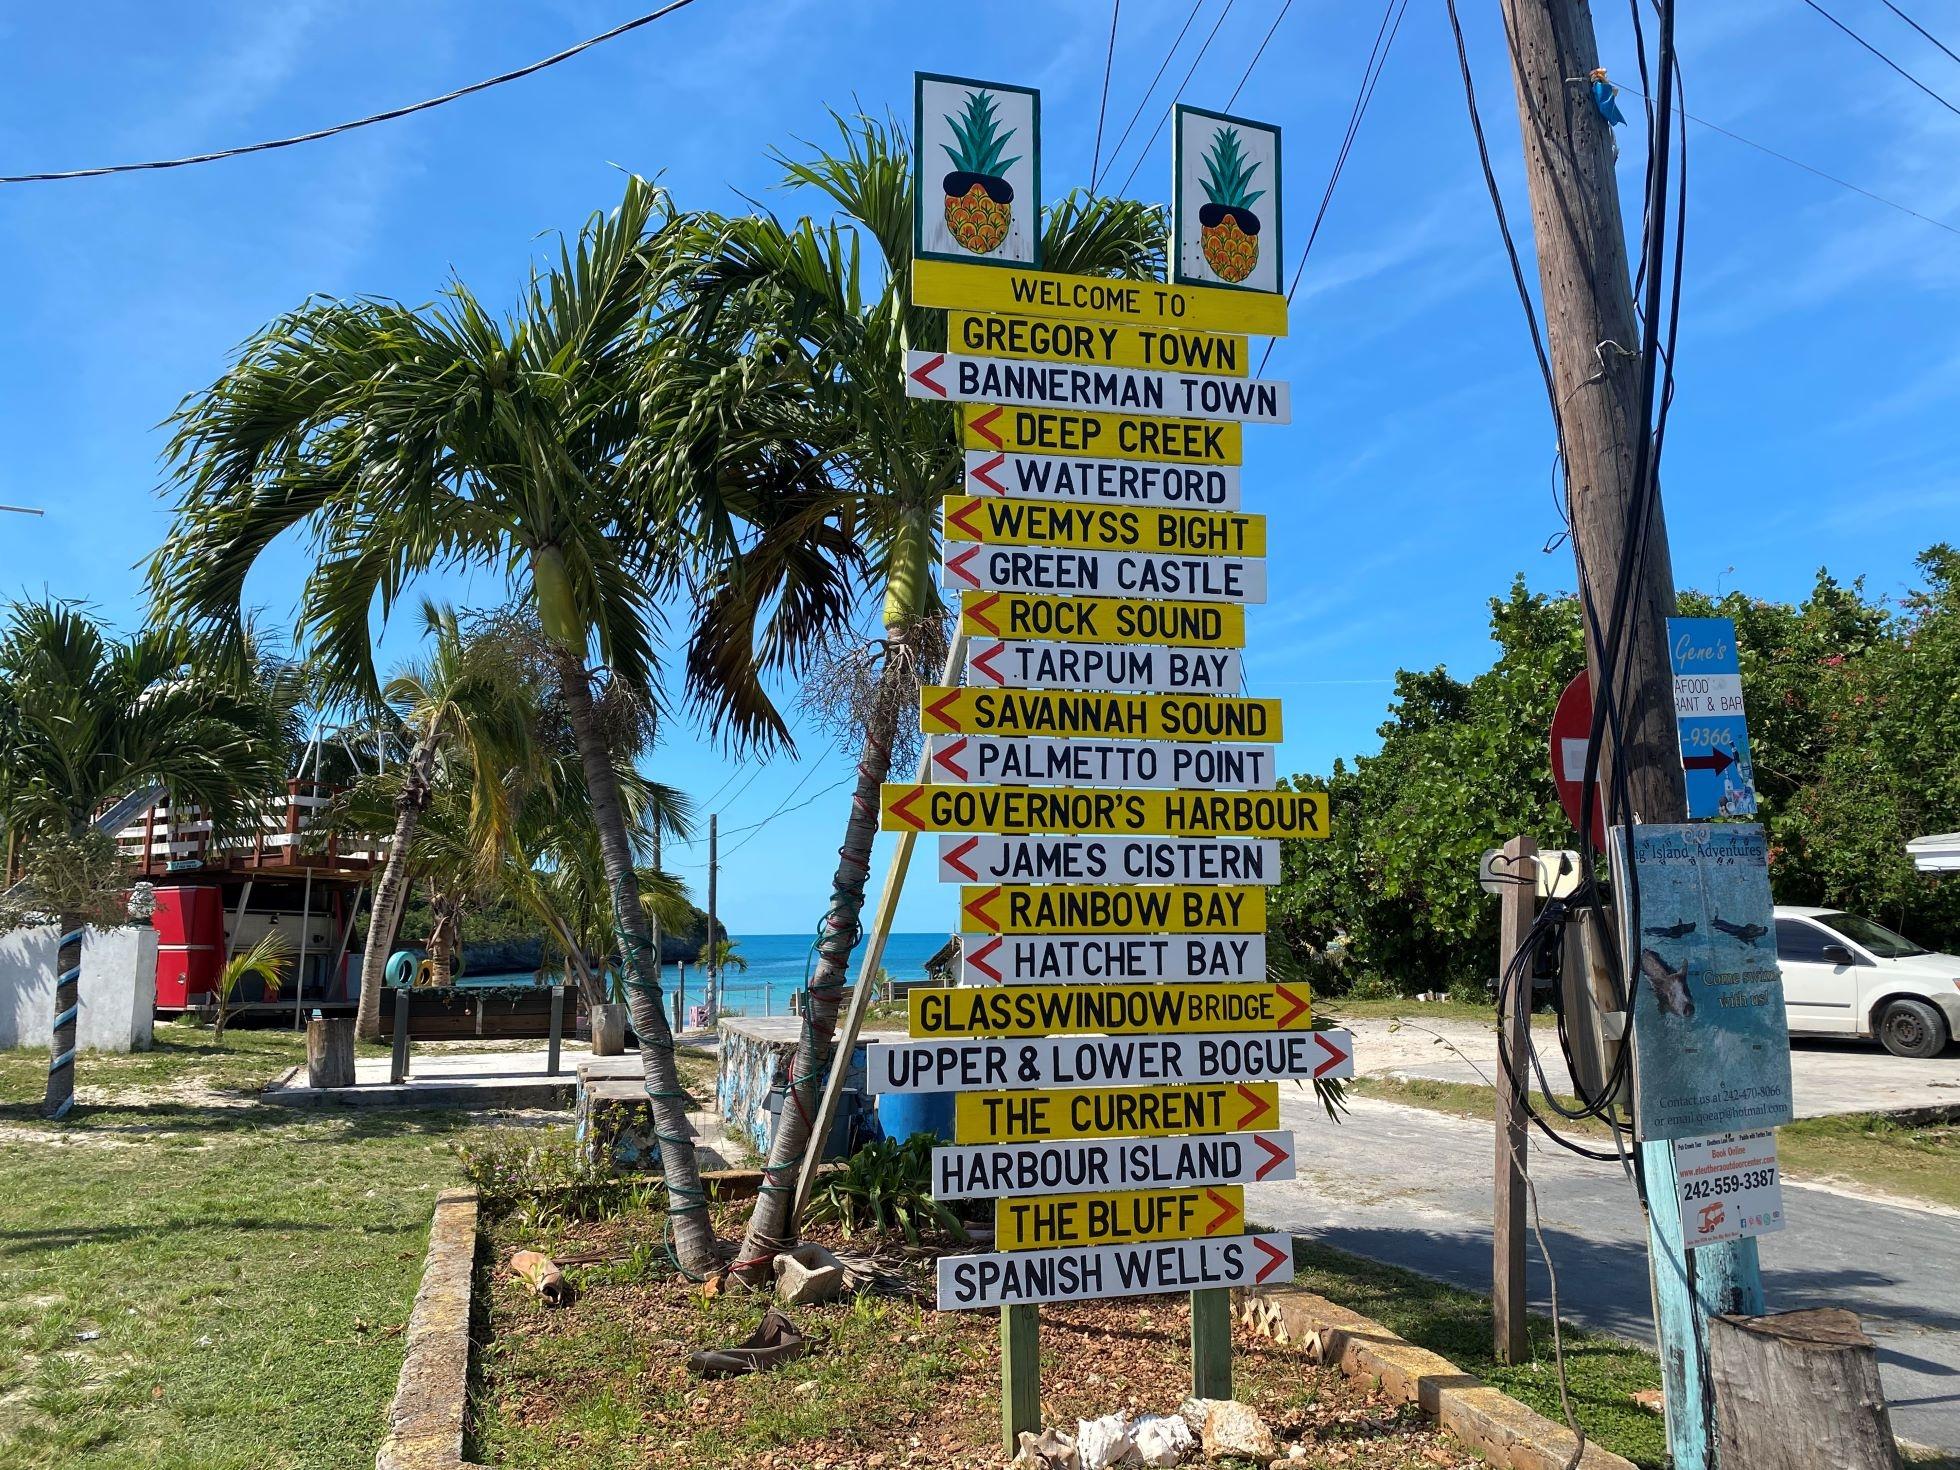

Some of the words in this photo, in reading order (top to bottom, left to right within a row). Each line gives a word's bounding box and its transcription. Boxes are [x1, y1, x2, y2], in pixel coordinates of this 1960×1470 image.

[1011, 278, 1140, 314] WELCOME
[1154, 292, 1186, 317] TO
[963, 317, 1118, 360] GREGORY
[1139, 332, 1236, 370] TOWN
[958, 361, 1163, 409] BANNERMAN
[1181, 379, 1277, 417] TOWN
[1015, 413, 1101, 450] DEEP
[1119, 420, 1225, 458] CREEK
[1015, 459, 1226, 503] WATERFORD
[987, 504, 1140, 545] WEMYSS
[1158, 514, 1249, 551] BIGHT
[989, 552, 1098, 590] GREEN
[1117, 558, 1243, 596] CASTLE
[1010, 600, 1098, 636] ROCK
[1116, 604, 1222, 640] SOUND
[1015, 648, 1153, 685] TARPUM
[1169, 653, 1228, 687] BAY
[1676, 634, 1727, 670] Gene's
[975, 695, 1148, 734] SAVANNAH
[1161, 700, 1267, 736] SOUND
[1708, 696, 1715, 711] &
[1721, 697, 1743, 711] BAR
[1681, 728, 1730, 746] -9366
[979, 744, 1158, 781] PALMETTO
[1174, 750, 1265, 785] POINT
[931, 791, 1146, 829] GOVERNOR'S
[1166, 797, 1319, 831] HARBOUR
[989, 842, 1106, 878] JAMES
[1124, 843, 1263, 879] CISTERN
[1653, 844, 1688, 859] Island
[1698, 844, 1762, 858] Adventures
[1010, 892, 1172, 927] RAINBOW
[1183, 892, 1245, 927] BAY
[1015, 941, 1169, 977] HATCHET
[1187, 940, 1250, 976] BAY
[1703, 970, 1740, 986] Come
[920, 991, 1185, 1032] GLASSWINDOW
[1188, 994, 1274, 1022] BRIDGE
[1719, 991, 1747, 1008] with
[888, 1046, 1007, 1087] UPPER
[1019, 1045, 1040, 1082] &
[1053, 1042, 1182, 1083] LOWER
[1200, 1038, 1308, 1076] BOGUE
[983, 1097, 1051, 1135] THE
[1070, 1091, 1226, 1132] CURRENT
[1654, 1117, 1664, 1126] or
[1667, 1112, 1694, 1125] email
[1660, 1097, 1697, 1108] Contact
[1700, 1096, 1710, 1105] us
[1712, 1094, 1720, 1102] at
[942, 1147, 1109, 1194] HARBOUR
[1120, 1141, 1242, 1182] ISLAND
[1680, 1156, 1775, 1178] www.eleutheraoutdoorcenter.com
[1712, 1149, 1726, 1159] Book
[1728, 1146, 1746, 1156] Online
[1684, 1168, 1775, 1201] 242-559-3387
[1010, 1202, 1078, 1243] THE
[1088, 1195, 1199, 1238] BLUFF
[954, 1254, 1101, 1302] SPANISH
